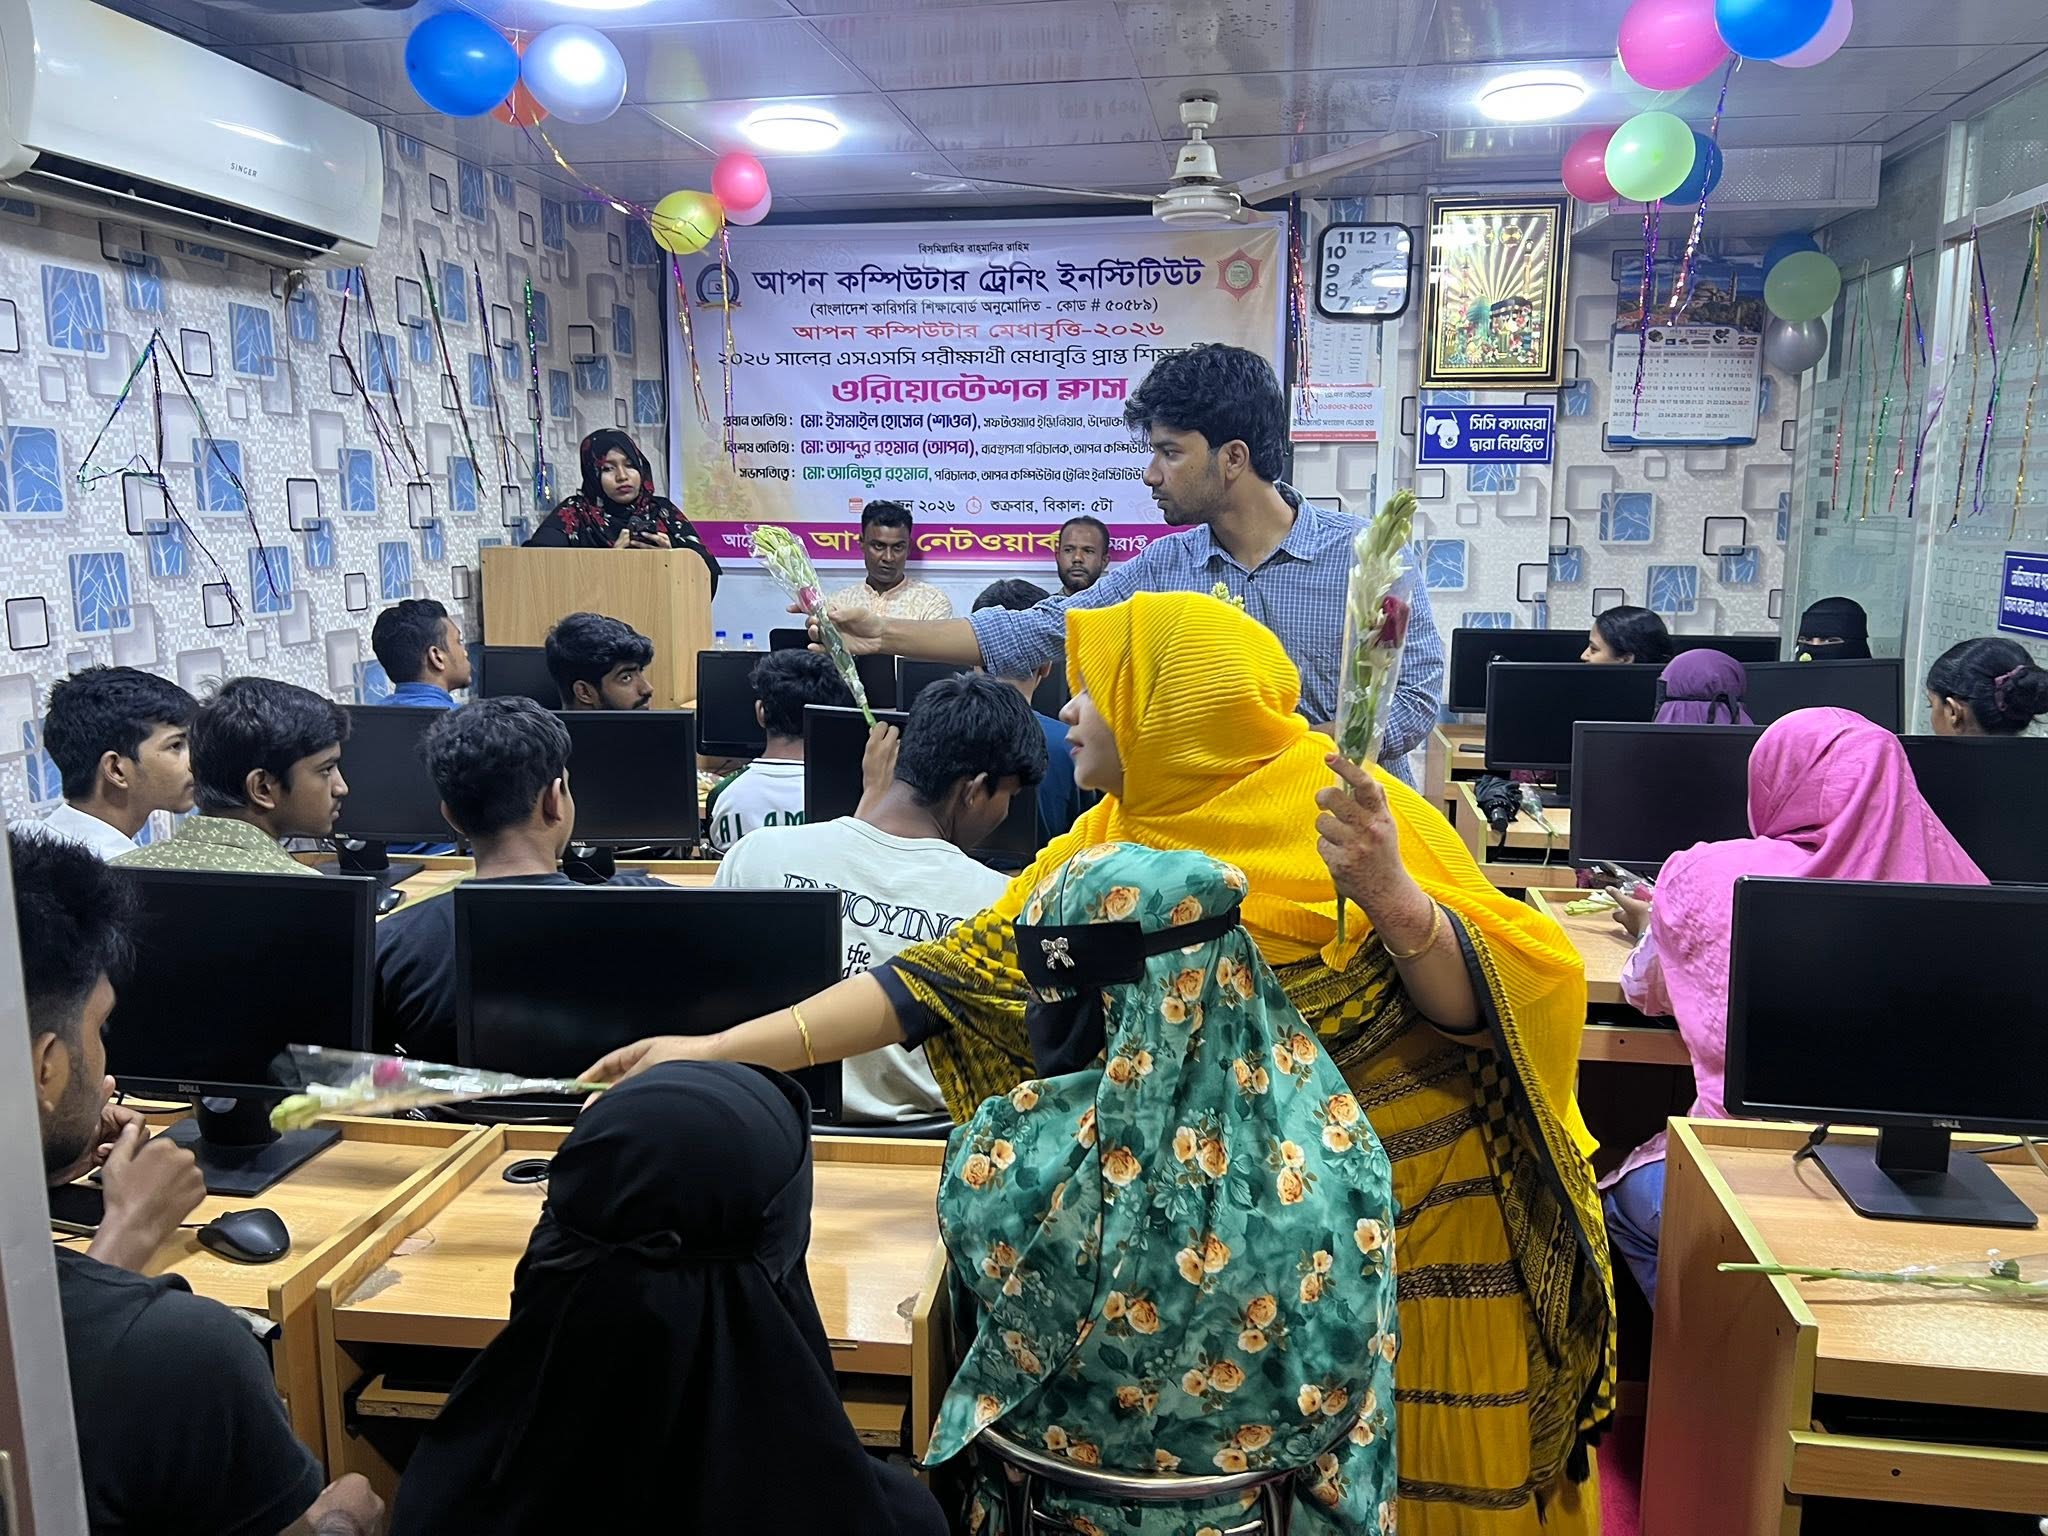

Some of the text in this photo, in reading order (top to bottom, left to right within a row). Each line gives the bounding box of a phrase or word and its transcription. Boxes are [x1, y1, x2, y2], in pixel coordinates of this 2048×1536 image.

[230, 162, 258, 177] SINGER
[1339, 232, 1353, 244] 11
[1359, 231, 1377, 244] 12
[1326, 246, 1346, 259] 10
[752, 268, 829, 295] আপন
[834, 262, 970, 294] কম্পিউটার
[979, 261, 1049, 295] ট্রেনিং
[1056, 255, 1206, 293] ইনস্টিটিউট
[1325, 263, 1340, 279] 9
[1325, 282, 1339, 298] 8
[810, 301, 868, 318] (বাংলাদেশ
[872, 299, 918, 315] কারিগরি
[921, 298, 977, 314] শিক্ষাবোর্ড
[981, 298, 1042, 316] অনুমোদিত
[1057, 297, 1087, 313] কোড
[1090, 298, 1100, 312] #
[1106, 297, 1158, 314] ৫০৫৮৯)
[1339, 296, 1351, 310] 7
[792, 324, 858, 340] আপন
[863, 320, 978, 340] কম্পিউটার
[718, 352, 770, 366] ২০২৬
[775, 352, 831, 366] সালের
[837, 346, 917, 366] এসএসসি
[1011, 344, 1087, 369] মেধাবৃত্তি
[1092, 347, 1129, 366] প্রাপ্ত
[832, 373, 1128, 404] ওরিয়েন্টেশন ক্লাস
[751, 413, 787, 427] অতিথি
[825, 410, 878, 431] ইসমাইল
[881, 414, 923, 430] হোসেন
[1469, 413, 1547, 431] সিসি ক্যামেরা
[755, 440, 789, 454] অতিথি
[826, 440, 871, 459] আব্দুর
[875, 440, 919, 456] রহমান
[1074, 443, 1102, 454] আপন
[1469, 434, 1545, 453] দ্বারা নিয়ন্ত্রিত
[981, 469, 1008, 480] আপন
[1010, 467, 1061, 480] কম্পিউটার
[1062, 467, 1090, 483] ট্রেনিং
[918, 500, 956, 513] ২০২৬
[1091, 497, 1114, 513] ৫টা
[847, 942, 871, 965] the
